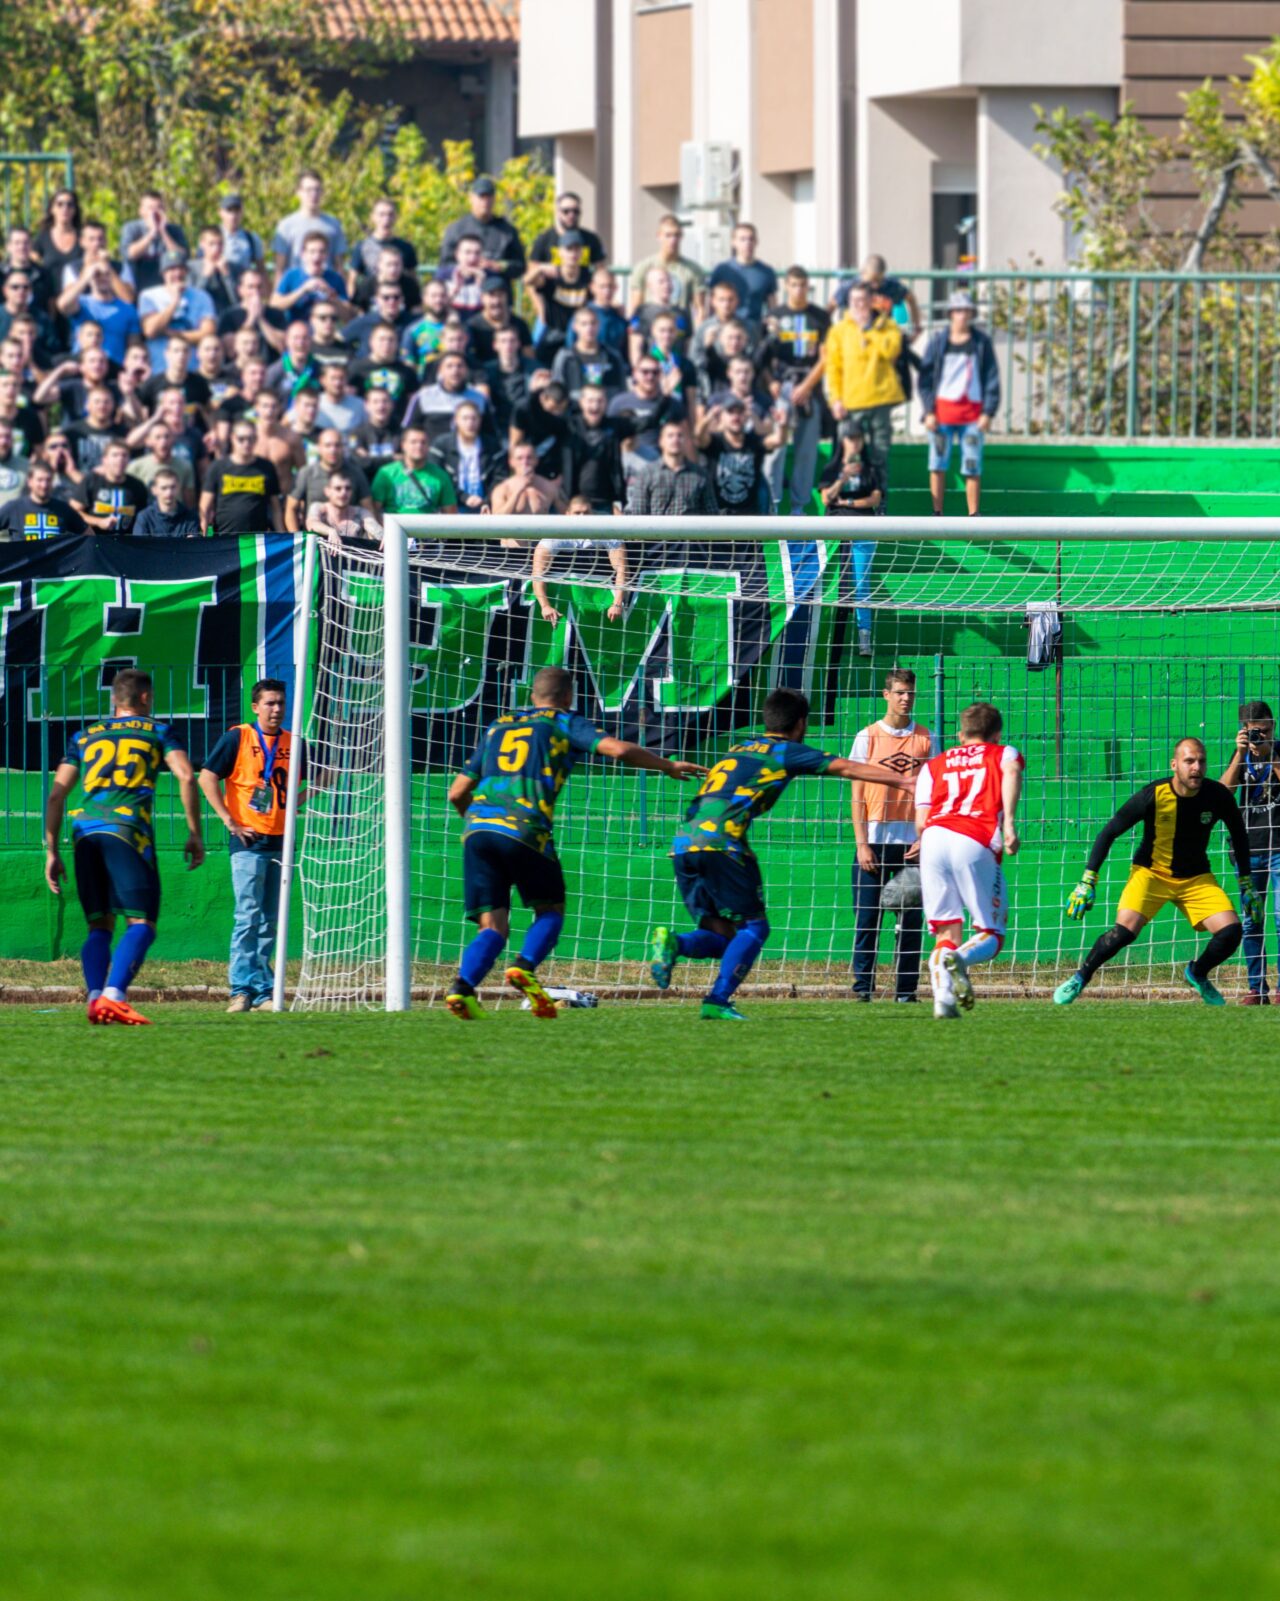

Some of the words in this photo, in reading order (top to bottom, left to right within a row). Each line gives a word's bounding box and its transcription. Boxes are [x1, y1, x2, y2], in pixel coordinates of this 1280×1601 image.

[84, 738, 147, 793] 25
[497, 727, 534, 772] 5
[698, 758, 738, 796] 6
[942, 767, 987, 816] 17
